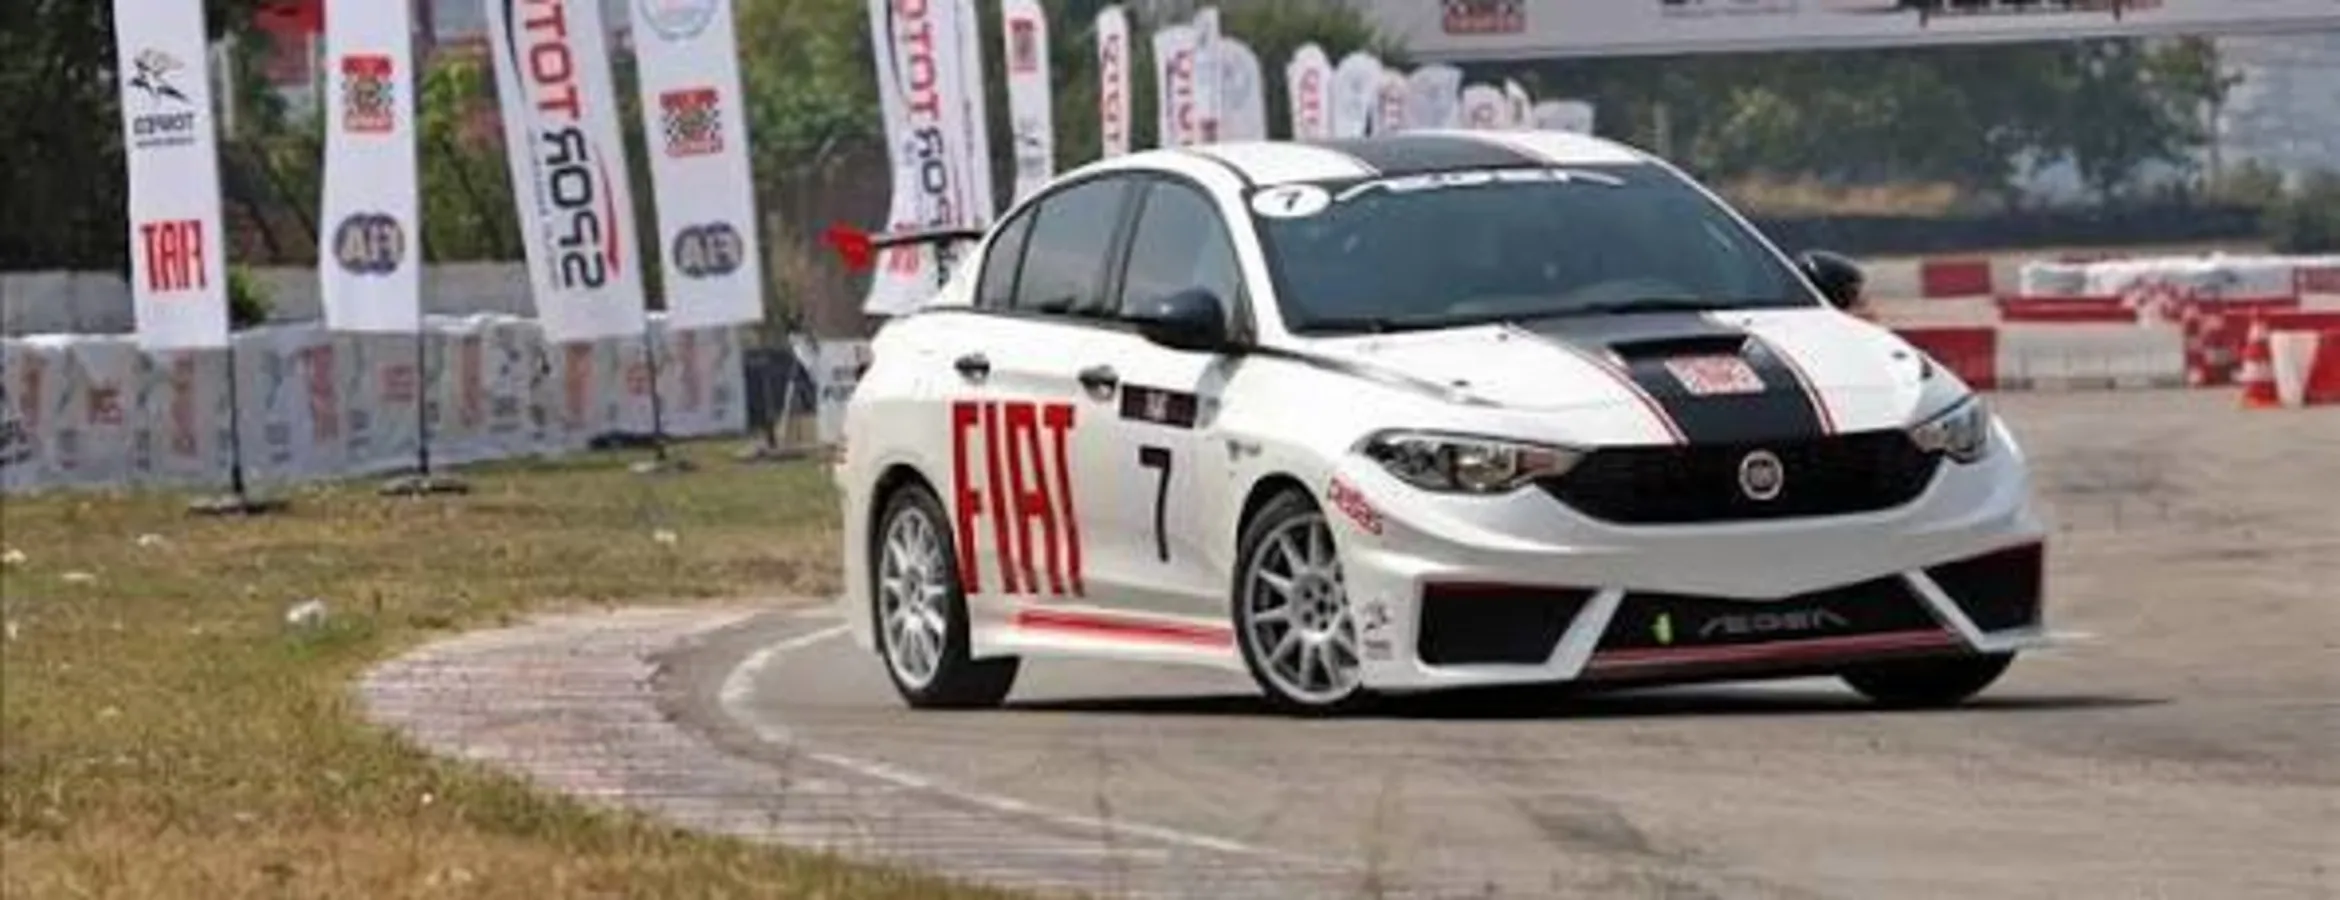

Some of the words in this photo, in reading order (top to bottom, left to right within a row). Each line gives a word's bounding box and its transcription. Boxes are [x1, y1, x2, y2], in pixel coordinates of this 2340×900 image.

[1276, 190, 1301, 211] 7
[952, 401, 1086, 598] FIAT
[1138, 445, 1172, 563] 7
